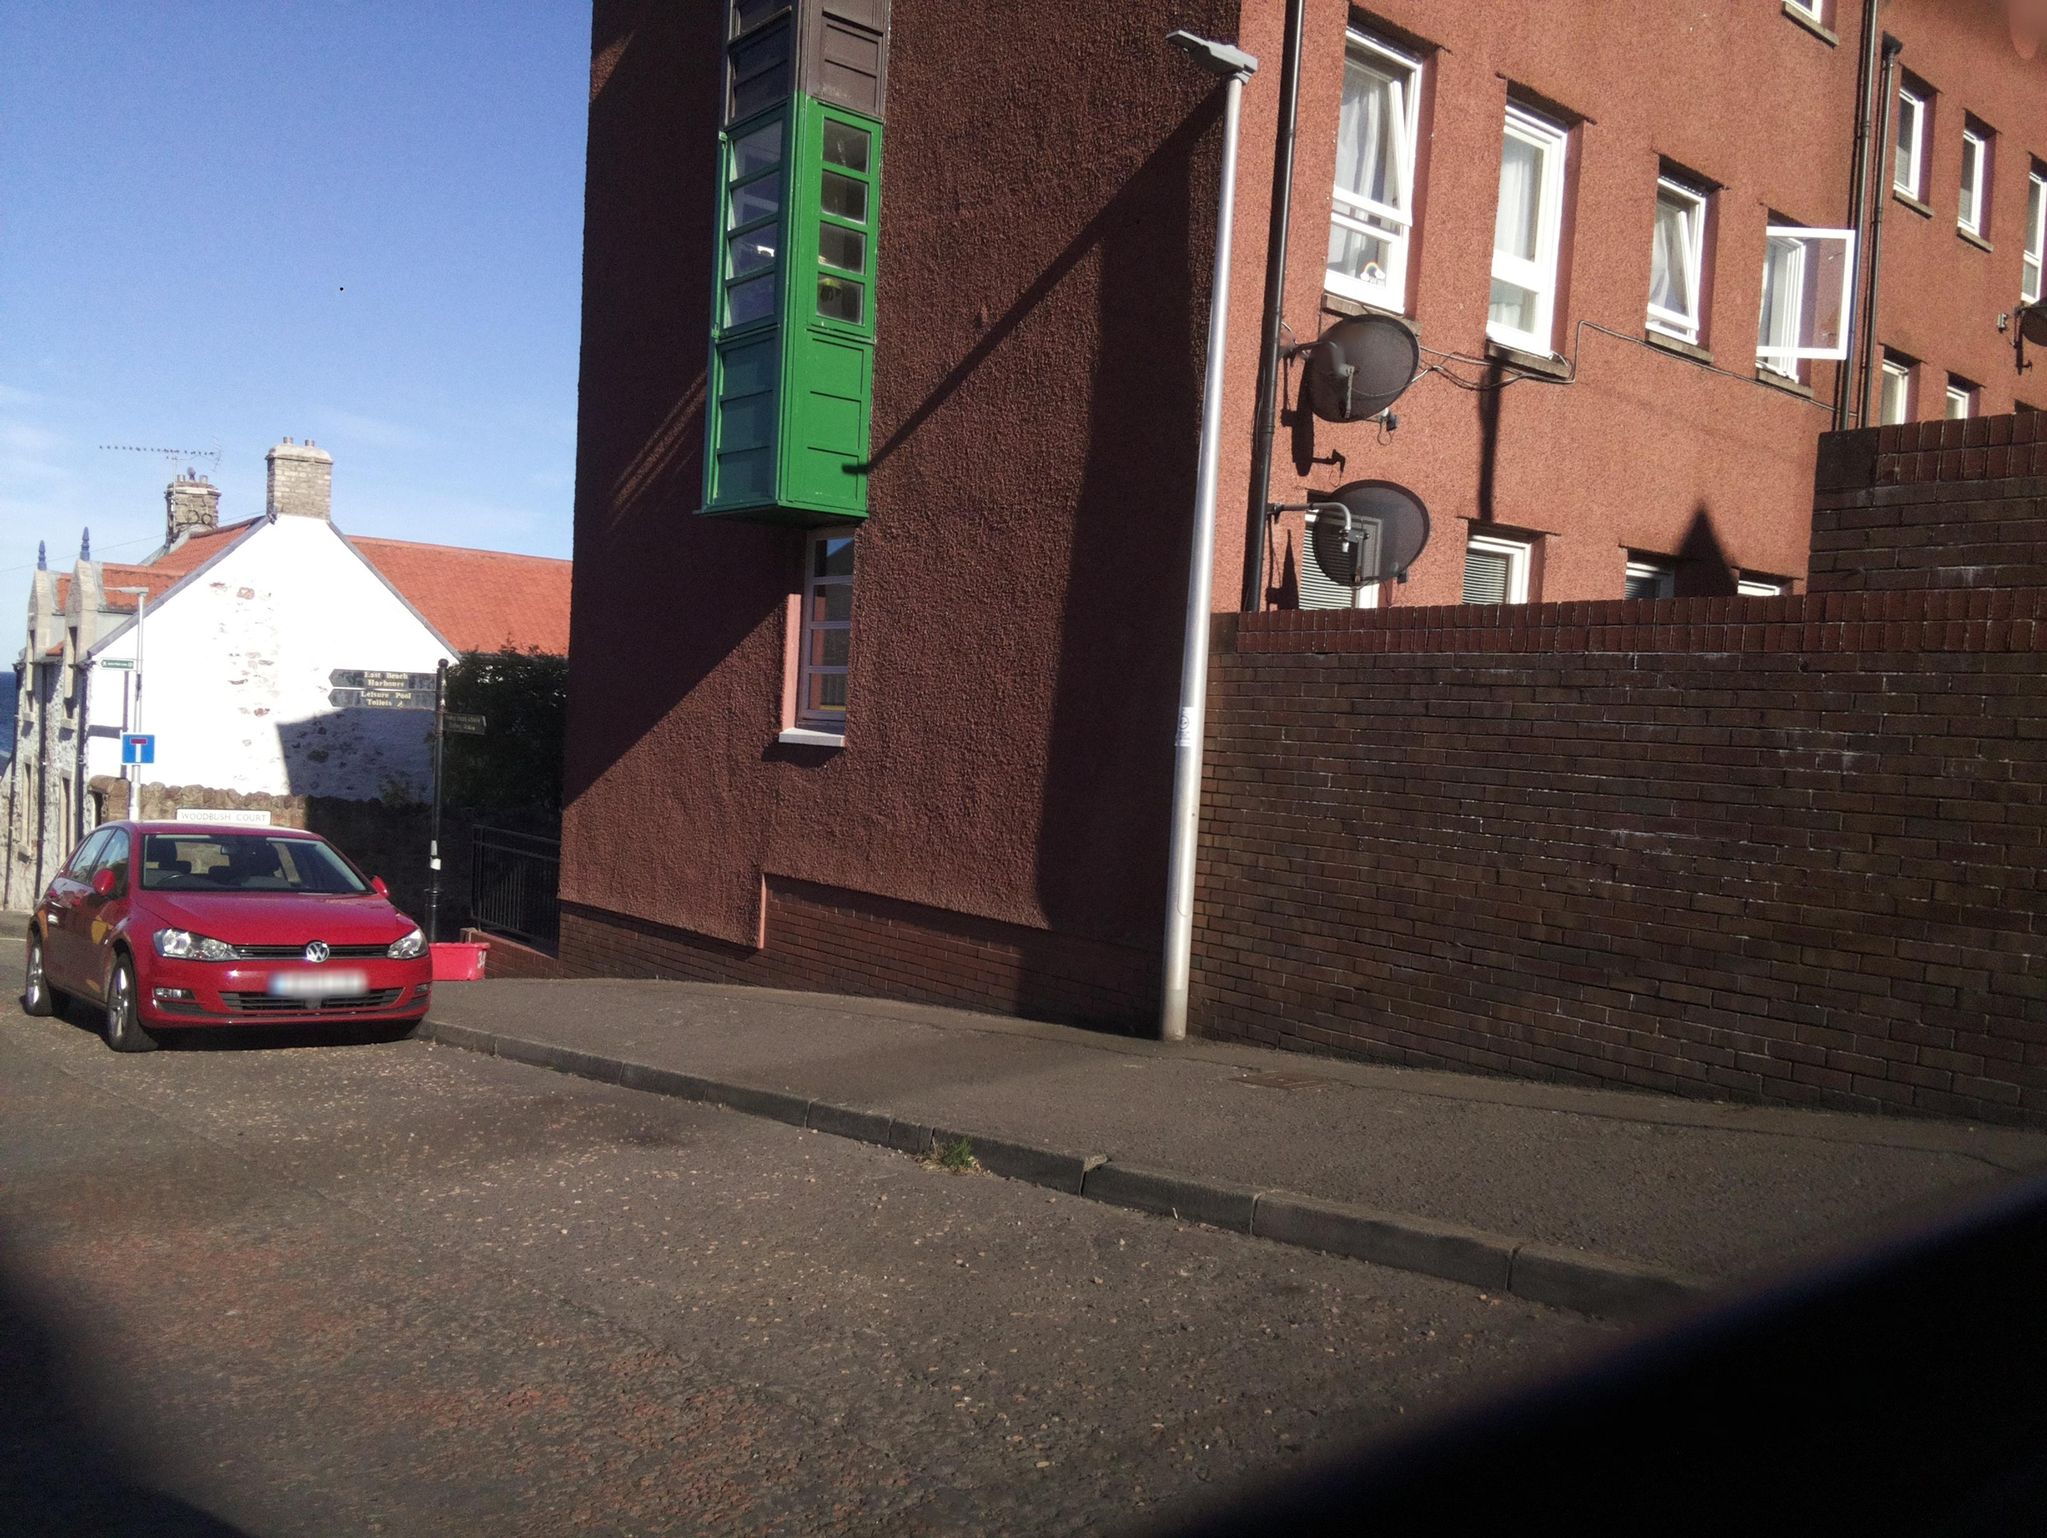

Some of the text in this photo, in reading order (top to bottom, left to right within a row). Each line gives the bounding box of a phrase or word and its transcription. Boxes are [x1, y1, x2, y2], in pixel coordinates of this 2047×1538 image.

[364, 671, 408, 680] East Beach
[361, 690, 389, 698] Leisure
[181, 812, 230, 820] WOODBUSH
[236, 814, 266, 822] COURT
